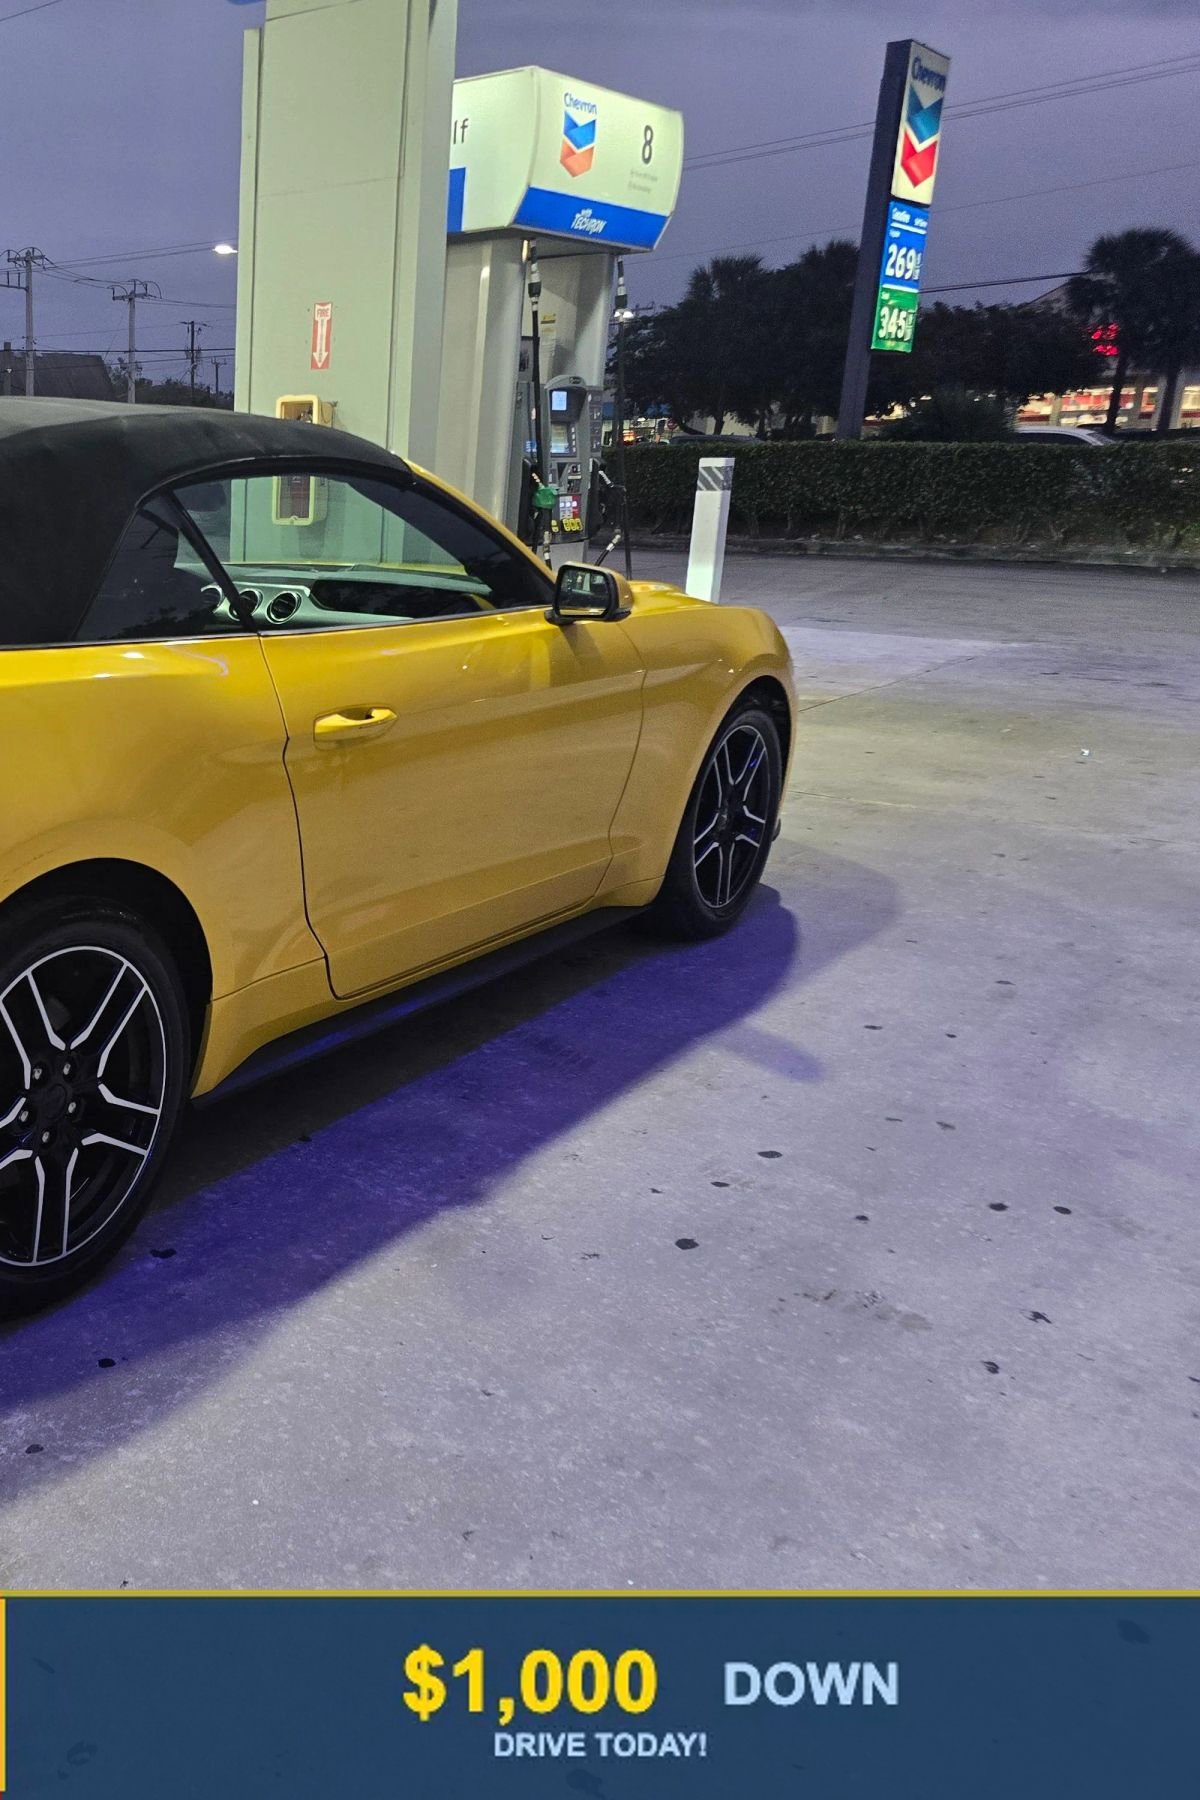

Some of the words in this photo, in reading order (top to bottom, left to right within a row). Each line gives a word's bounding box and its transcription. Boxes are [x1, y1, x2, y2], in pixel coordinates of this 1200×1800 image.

[911, 55, 947, 93] Chevron
[563, 92, 598, 115] Chevron
[641, 125, 654, 165] 8
